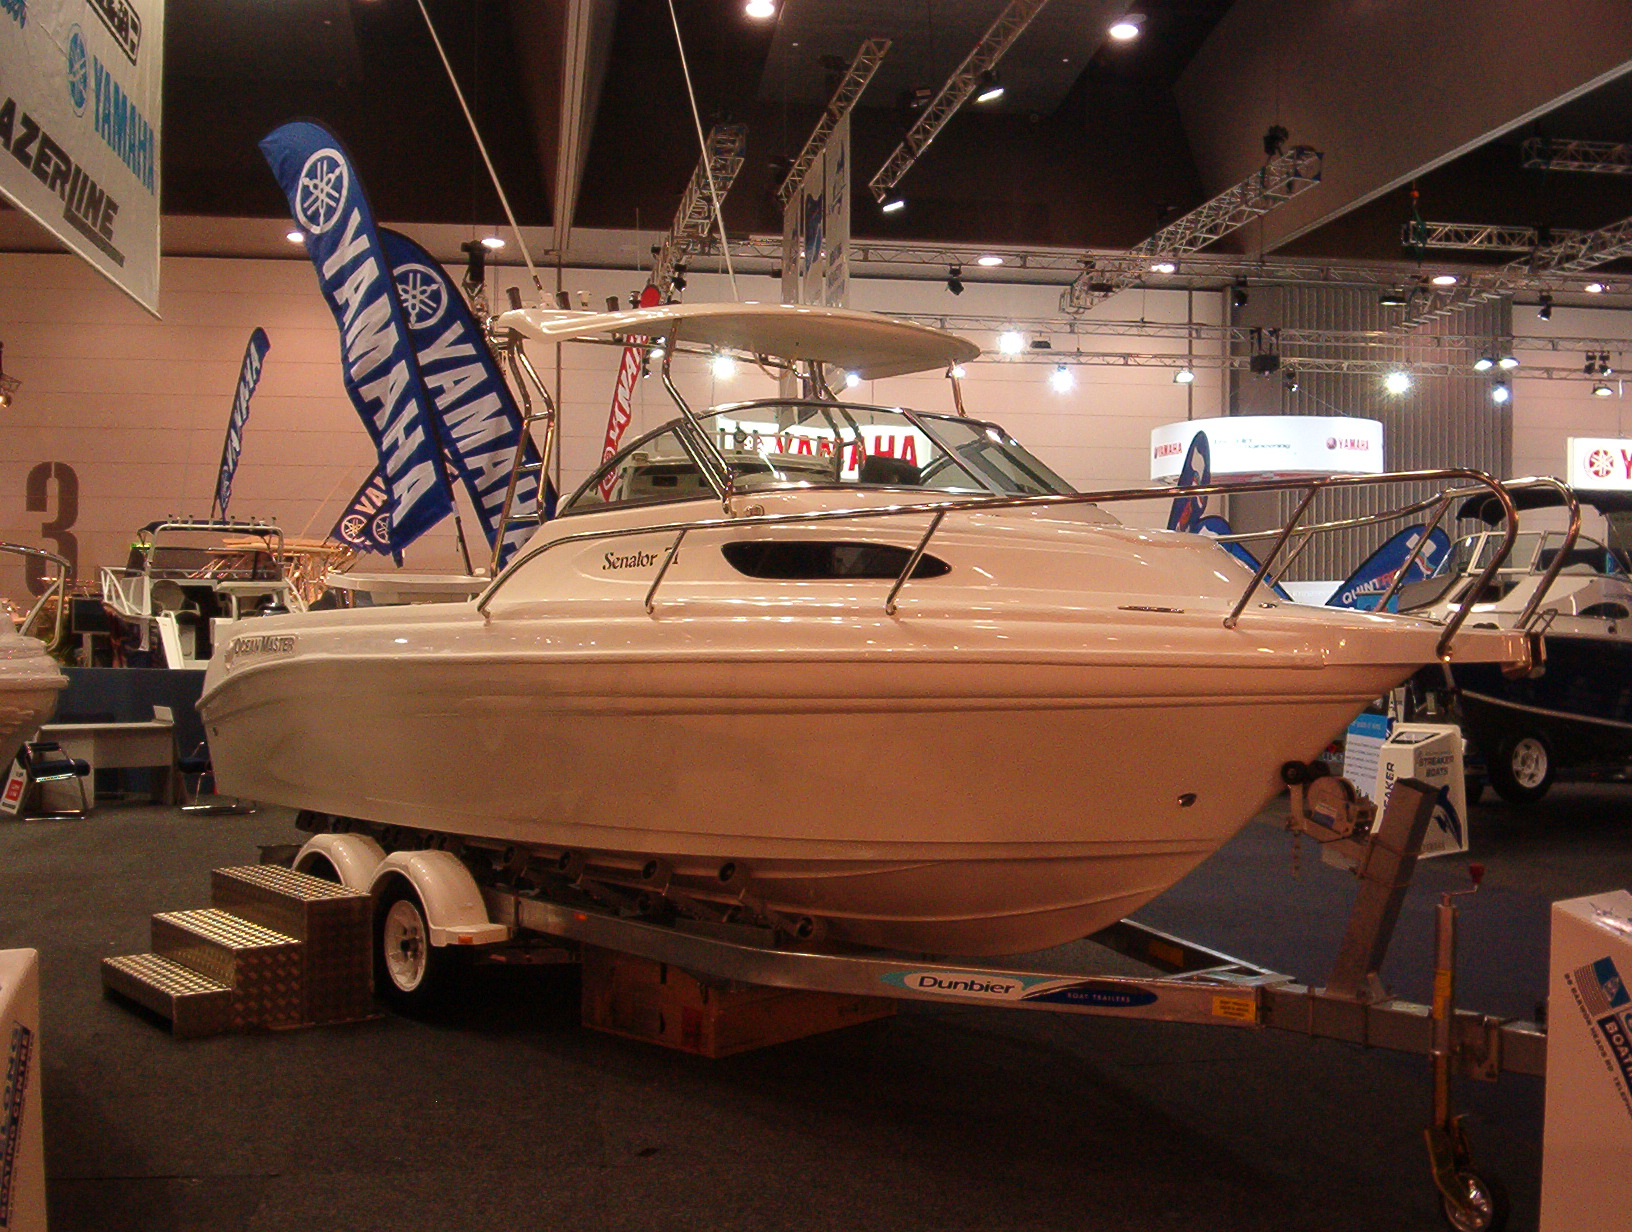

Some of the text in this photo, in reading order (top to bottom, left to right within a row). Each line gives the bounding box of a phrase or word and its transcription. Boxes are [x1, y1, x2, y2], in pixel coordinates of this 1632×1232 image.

[322, 207, 437, 528] YAMAHA
[1338, 438, 1370, 451] YAMAHA
[26, 461, 79, 598] 3
[602, 550, 659, 571] Senator
[234, 635, 296, 656] OCEAN MASTER
[917, 974, 1016, 996] Dunbier
[1066, 991, 1089, 1001] BOAT
